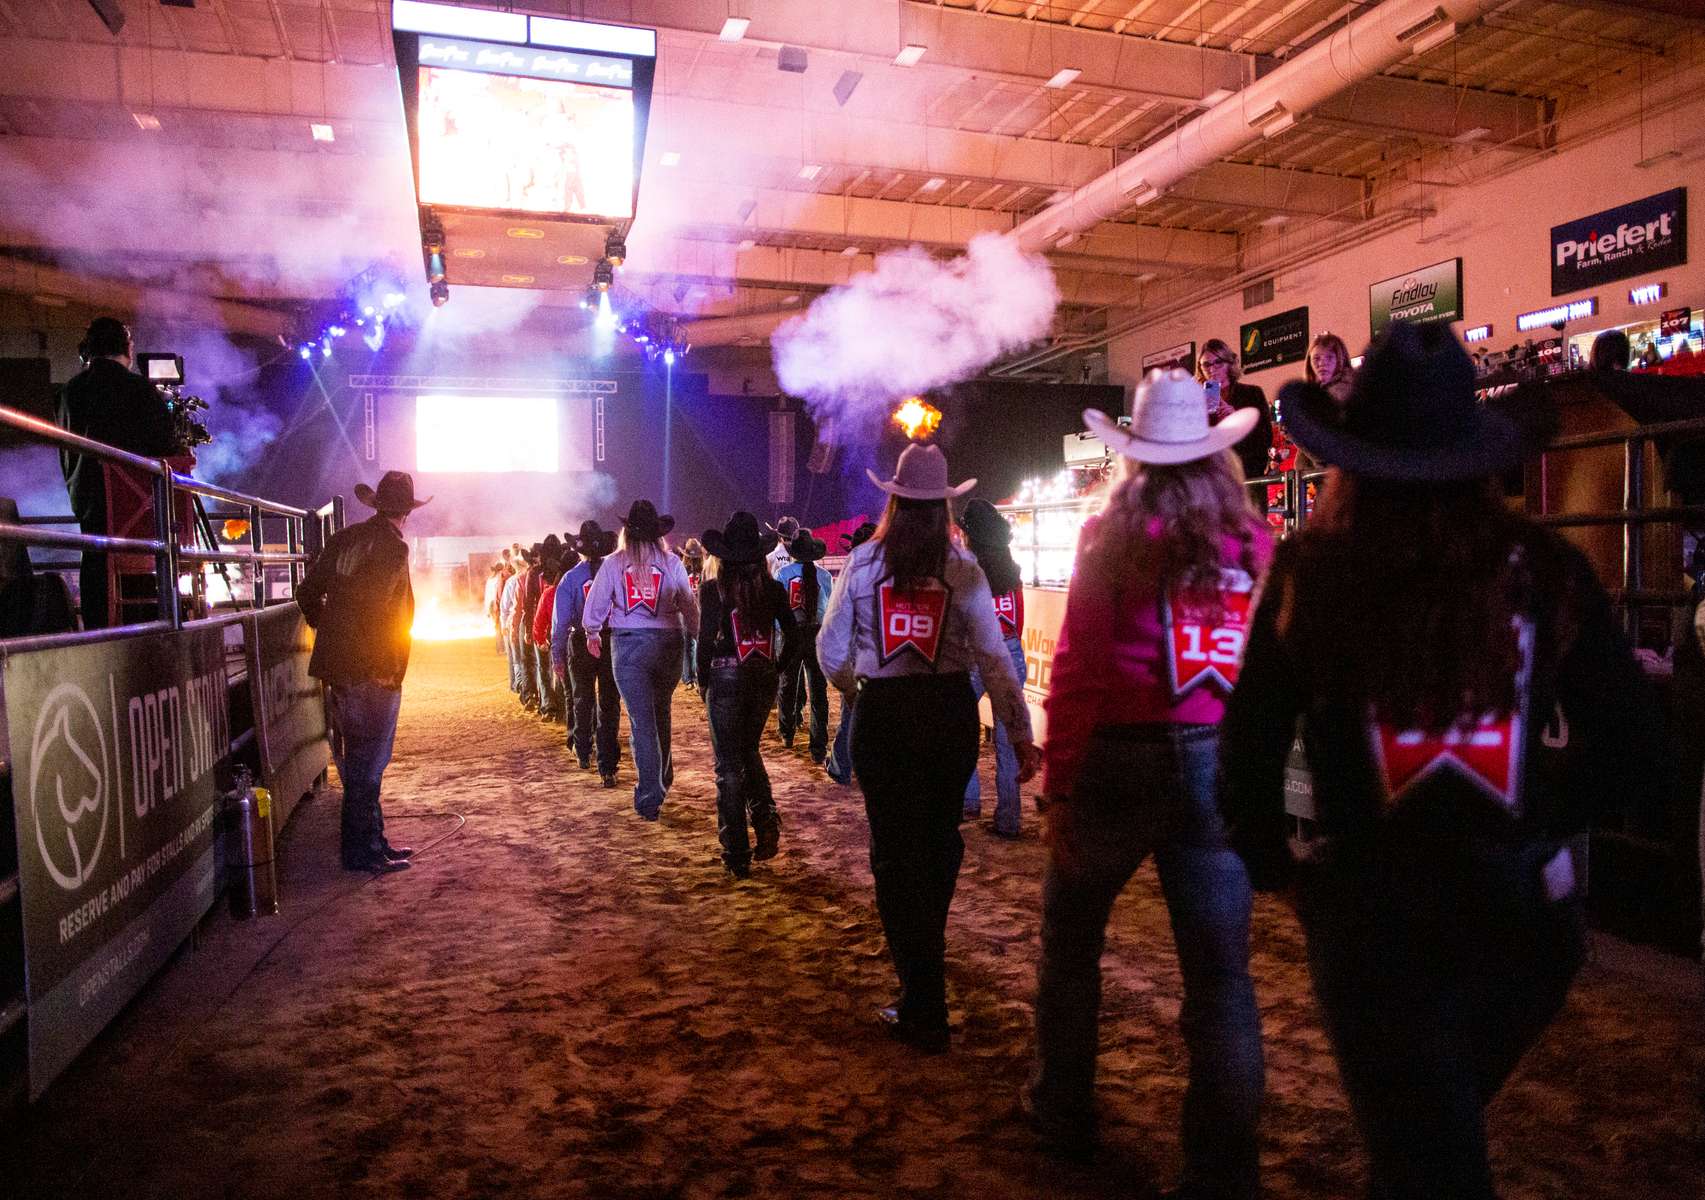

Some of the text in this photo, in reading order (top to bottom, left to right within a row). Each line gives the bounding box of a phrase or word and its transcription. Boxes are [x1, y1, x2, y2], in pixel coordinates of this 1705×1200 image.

[1556, 212, 1672, 266] Priefert
[1577, 258, 1602, 270] Farm,
[1604, 248, 1633, 262] Ranch
[1391, 282, 1438, 306] Findlay
[1389, 303, 1434, 321] TOYOTA
[1662, 317, 1689, 328] 107
[1263, 331, 1303, 347] EQUIPMENT
[1537, 346, 1562, 357] 106
[890, 613, 934, 638] 09
[1181, 625, 1244, 664] 13
[129, 686, 184, 818] OPEN
[186, 667, 229, 783] STALLS
[60, 889, 108, 944] RESERVE
[111, 873, 130, 906] AND
[130, 863, 146, 891] PAY
[147, 849, 161, 878] FOR
